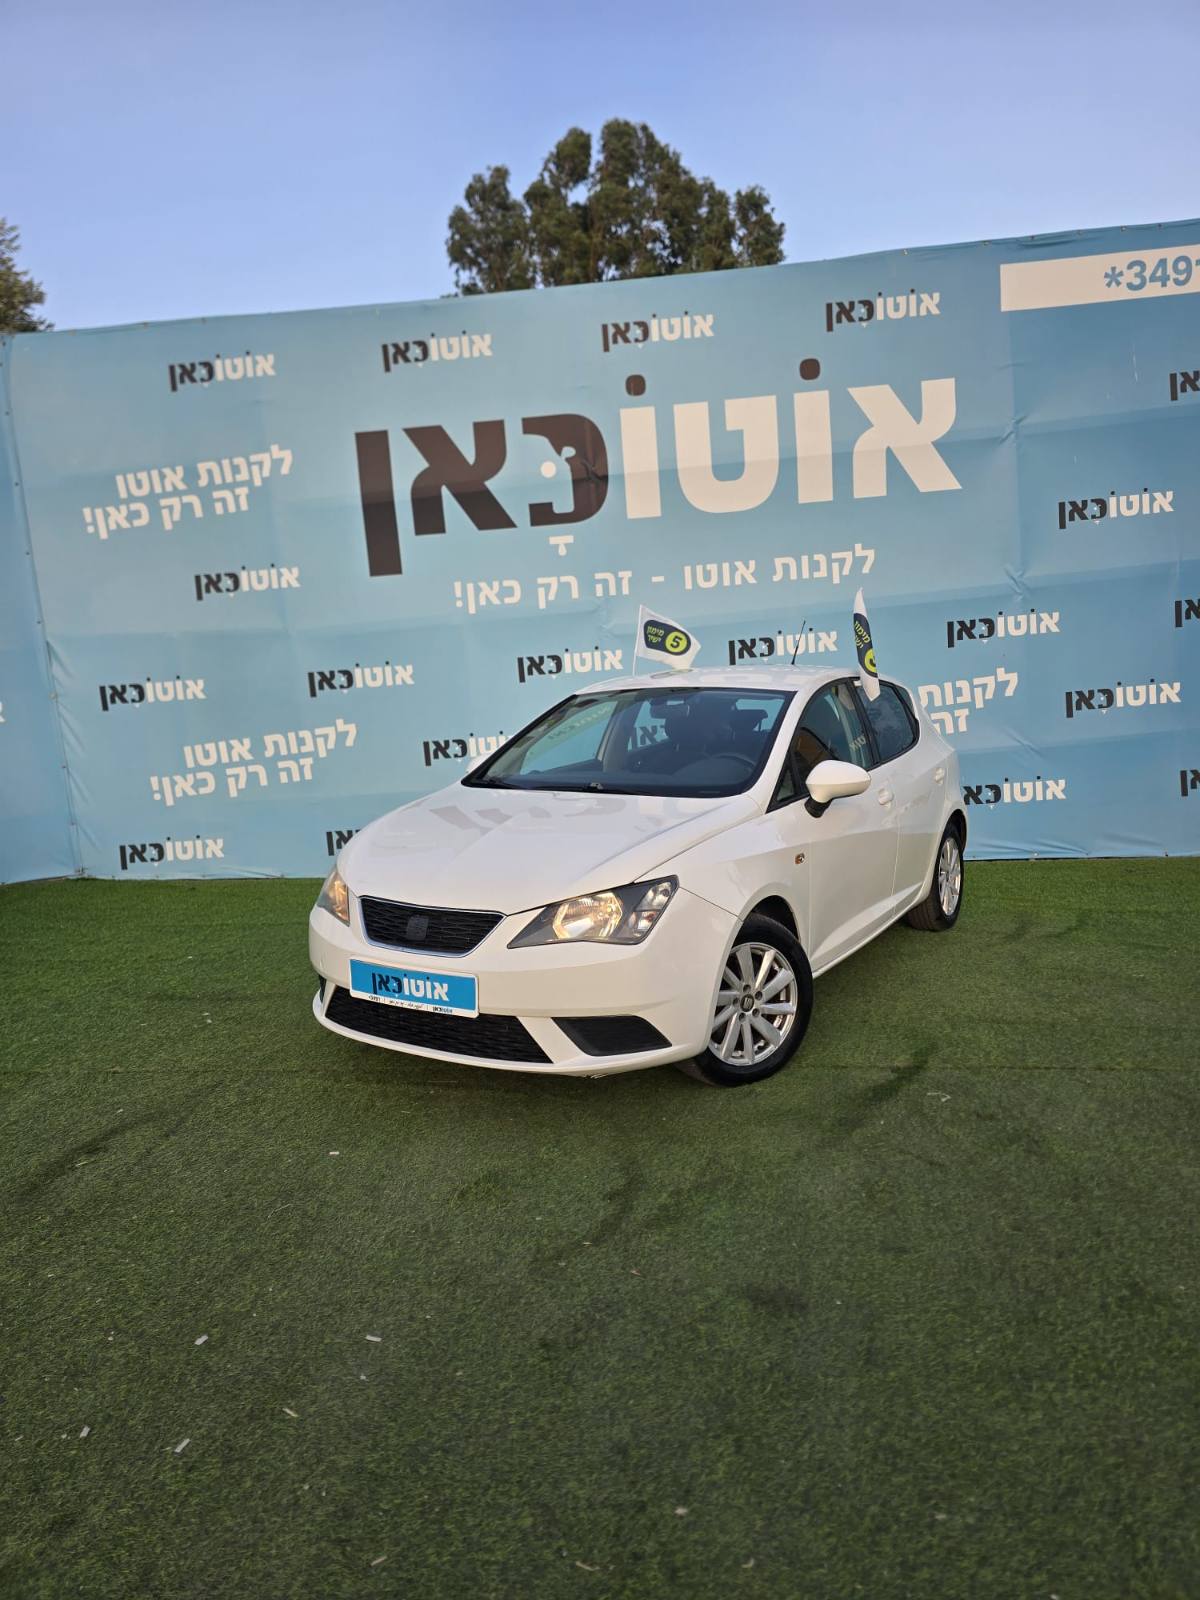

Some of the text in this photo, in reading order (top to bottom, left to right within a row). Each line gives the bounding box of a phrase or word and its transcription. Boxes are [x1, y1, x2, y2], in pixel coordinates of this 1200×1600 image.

[1104, 255, 1200, 291] 349
[117, 444, 293, 501] לקנות אוטו
[84, 487, 249, 539] זה רק כאן!
[683, 560, 756, 592] אוטו
[773, 544, 876, 584] לקנות
[454, 578, 521, 614] כאן!
[537, 574, 581, 609] רק
[593, 570, 632, 596] זה
[670, 635, 683, 649] 5
[917, 667, 1018, 709] לקנות
[930, 708, 969, 735] זה
[184, 720, 357, 768] לקנות אוטו
[150, 756, 313, 805] זה רק כאן!
